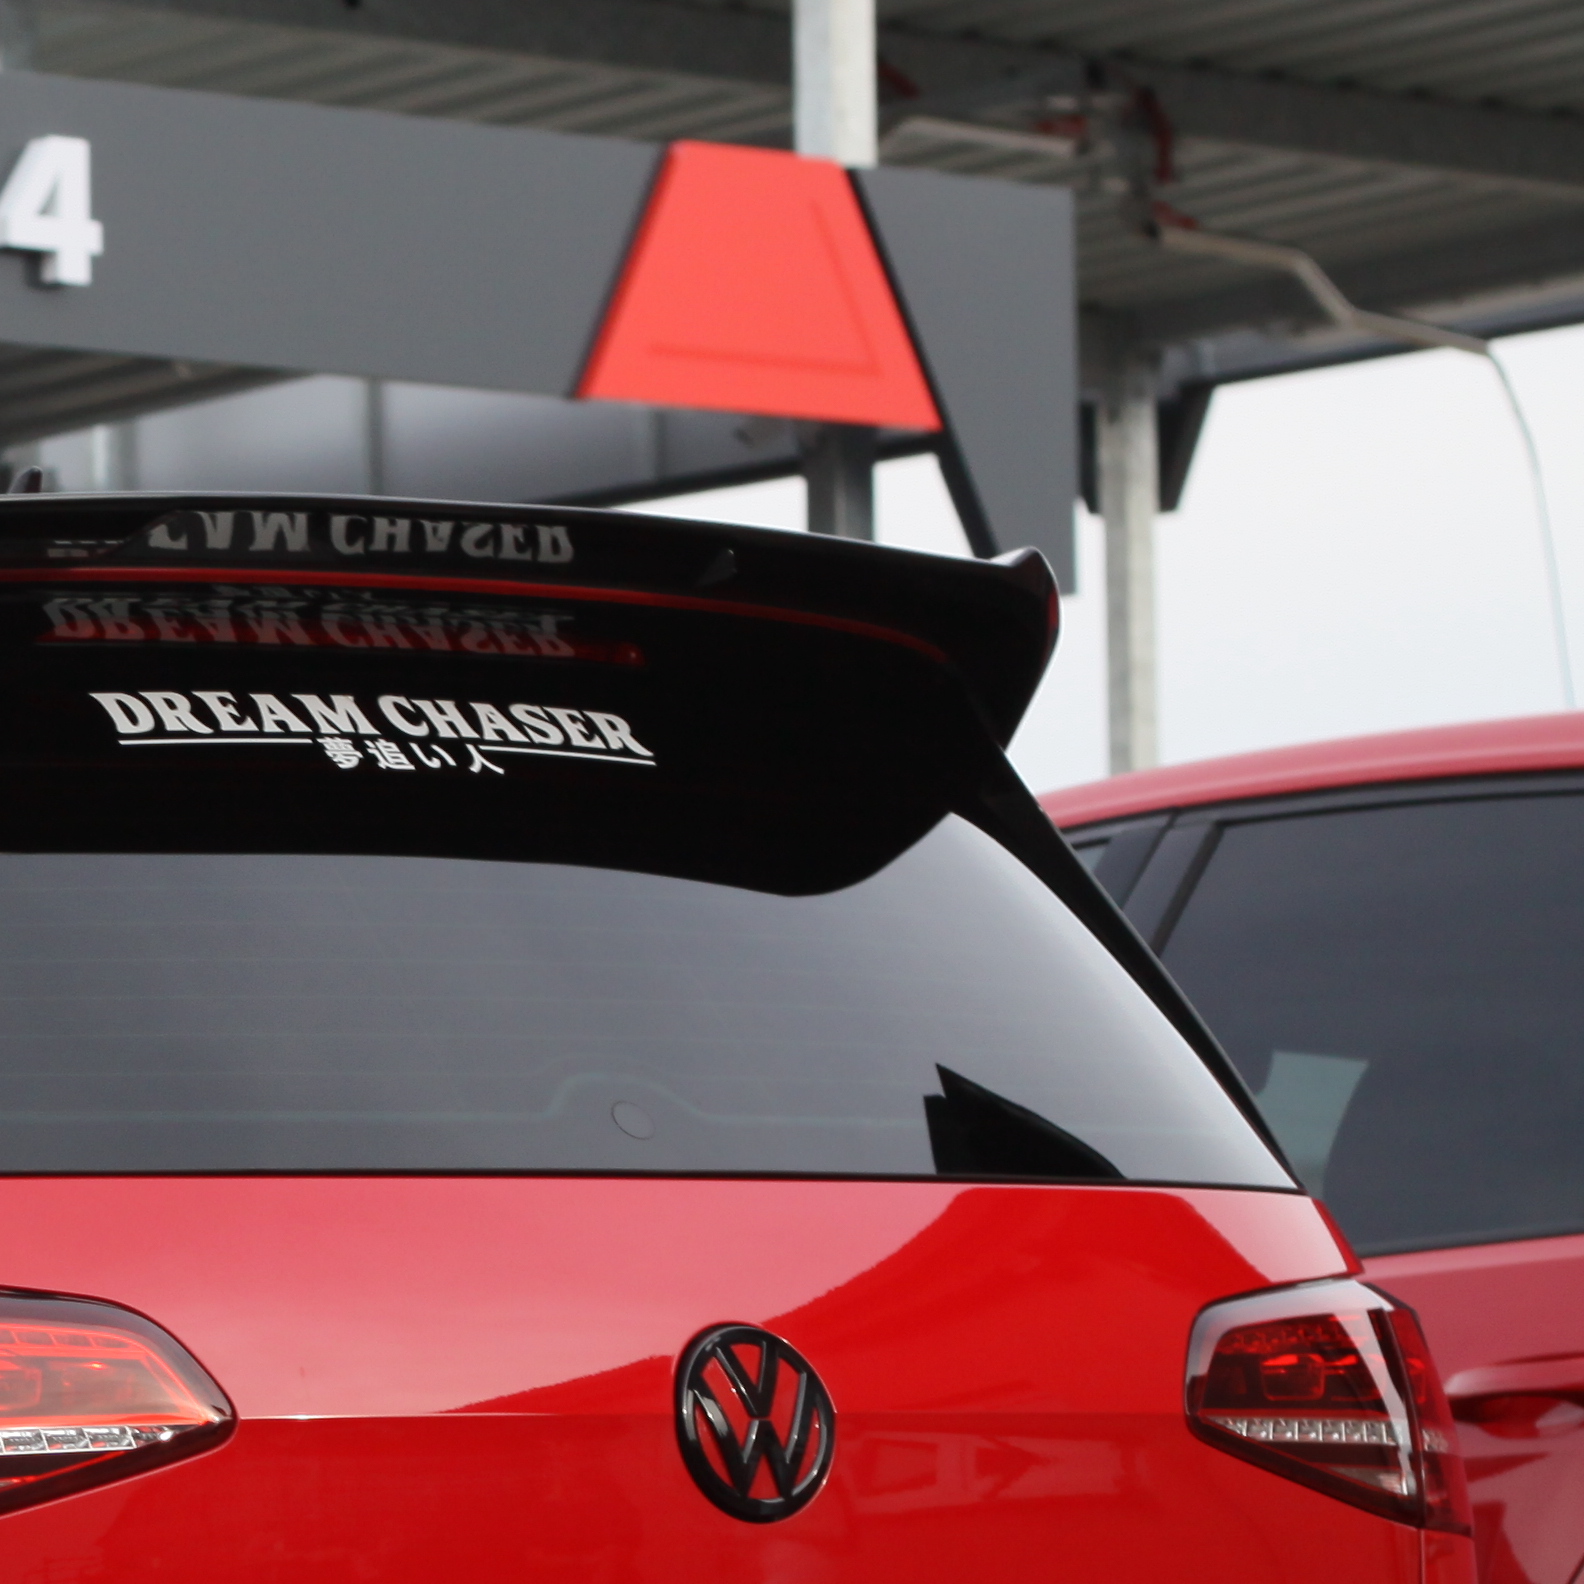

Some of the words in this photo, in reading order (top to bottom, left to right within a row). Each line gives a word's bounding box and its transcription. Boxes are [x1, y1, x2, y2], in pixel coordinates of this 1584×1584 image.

[89, 691, 381, 736] DREAM
[376, 694, 654, 757] CHASER
[317, 737, 505, 775] 夢追い人
